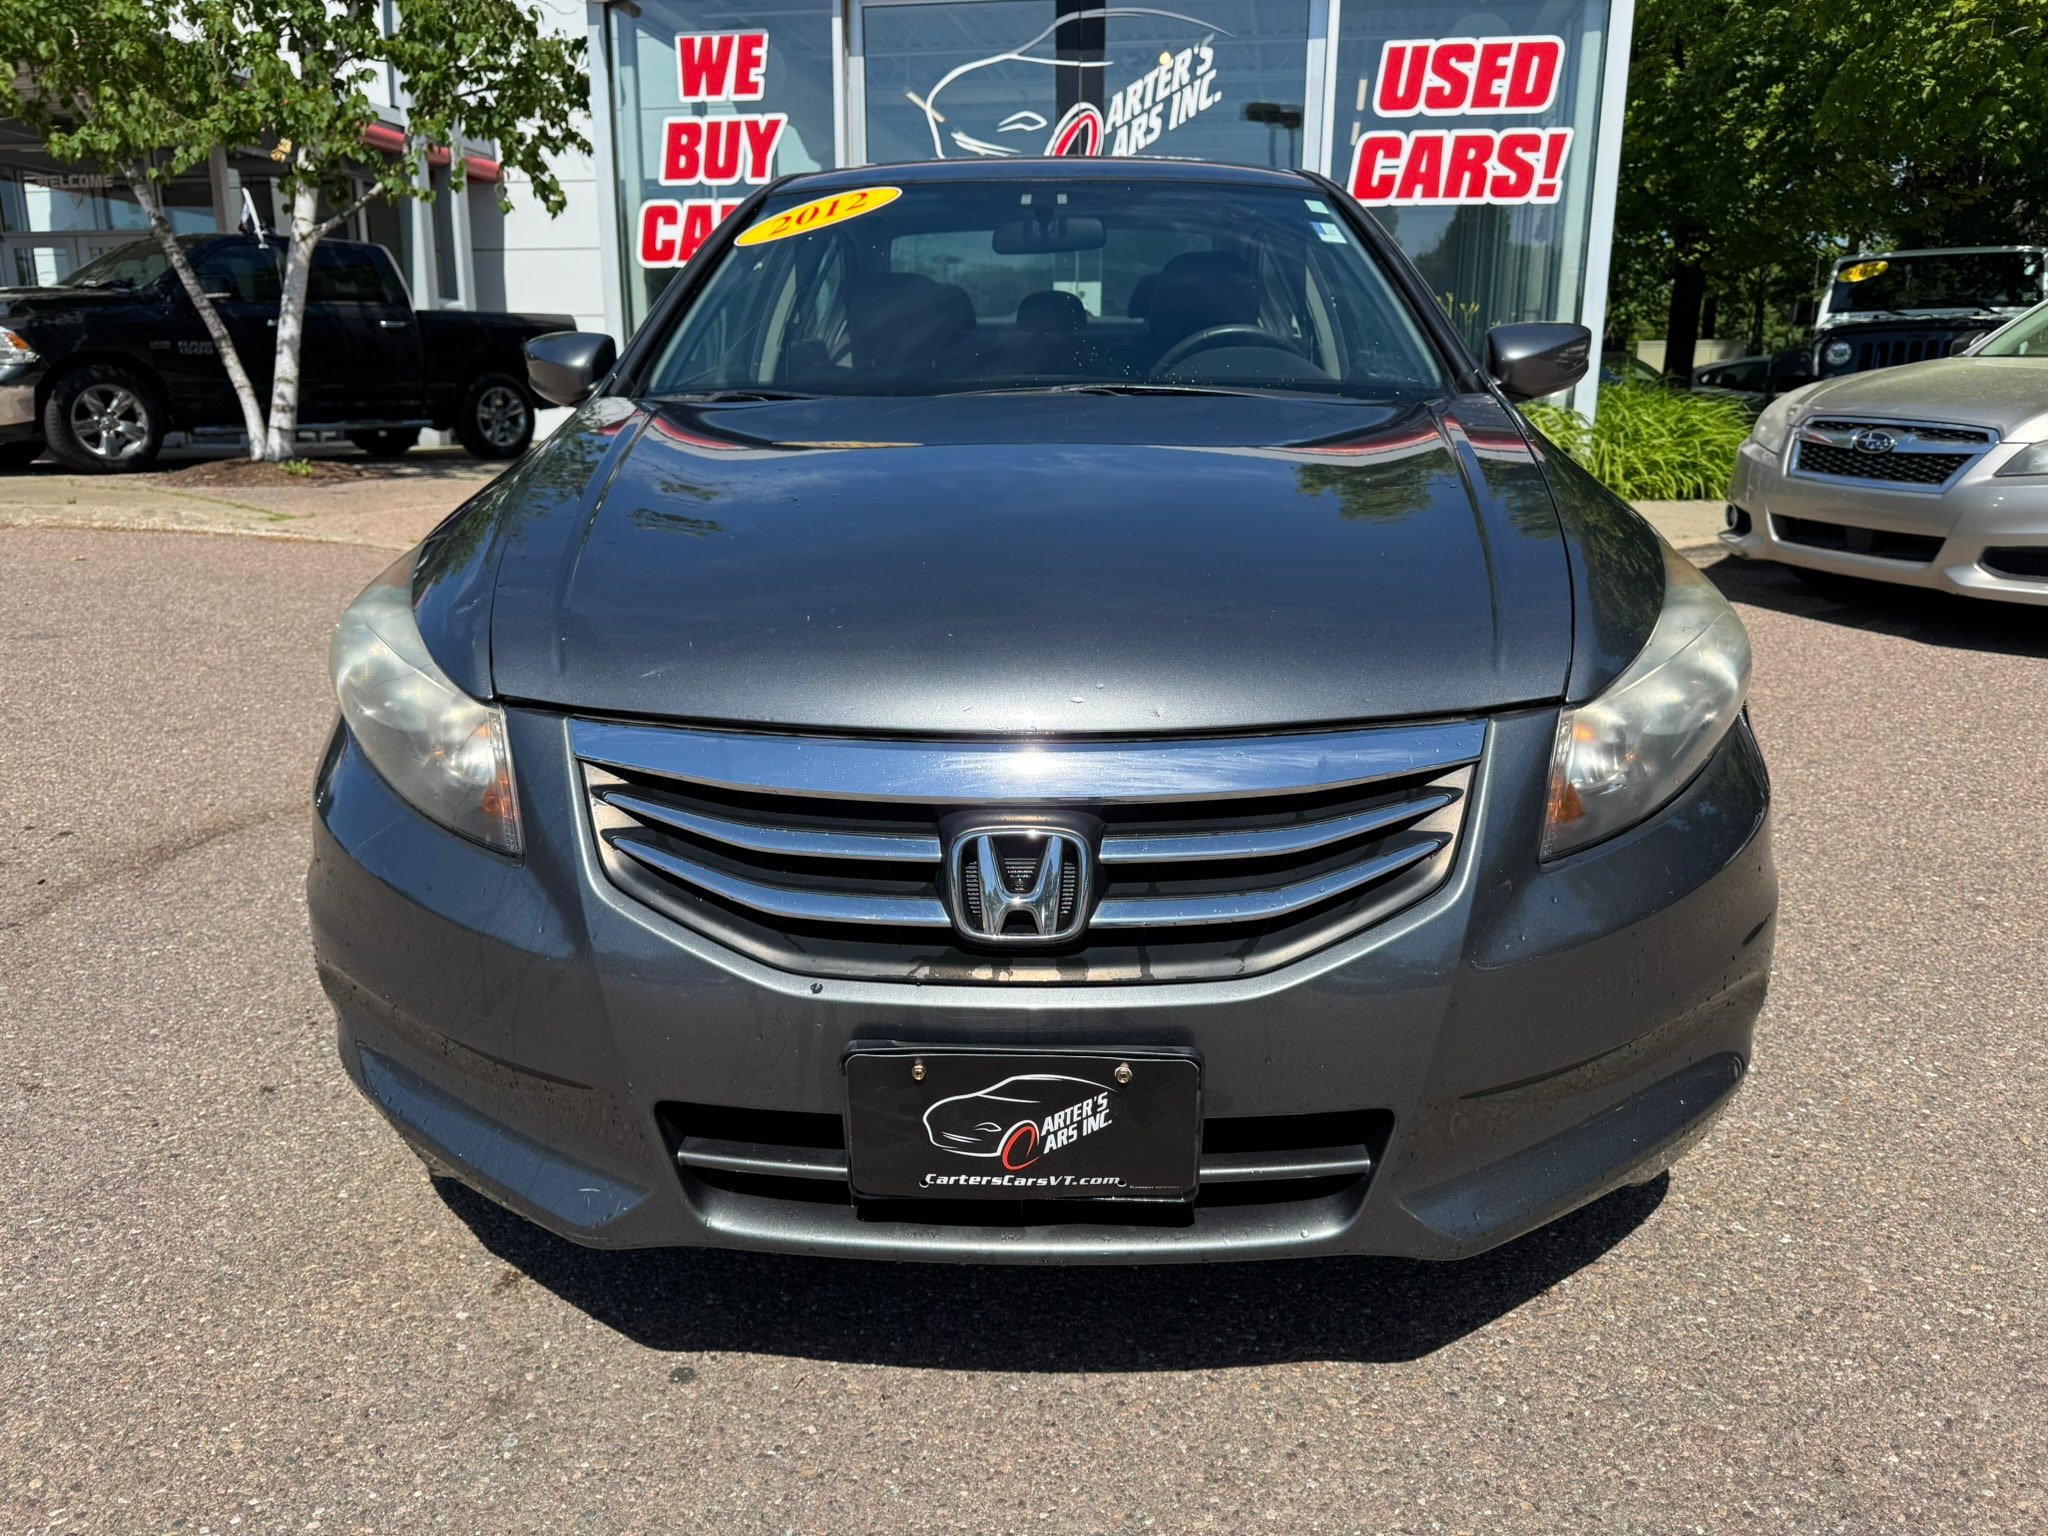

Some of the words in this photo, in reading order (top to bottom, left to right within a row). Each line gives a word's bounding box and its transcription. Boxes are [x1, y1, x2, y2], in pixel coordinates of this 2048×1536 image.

[677, 31, 766, 99] WE
[1376, 38, 1561, 114] USED
[1168, 68, 1222, 131] INC.
[662, 116, 785, 183] BUY
[1350, 130, 1570, 202] CARS!
[639, 202, 740, 265] CA
[768, 192, 868, 237] 2012
[1082, 1108, 1113, 1136] INC.
[925, 1173, 1120, 1187] CartersCarsVT.com
